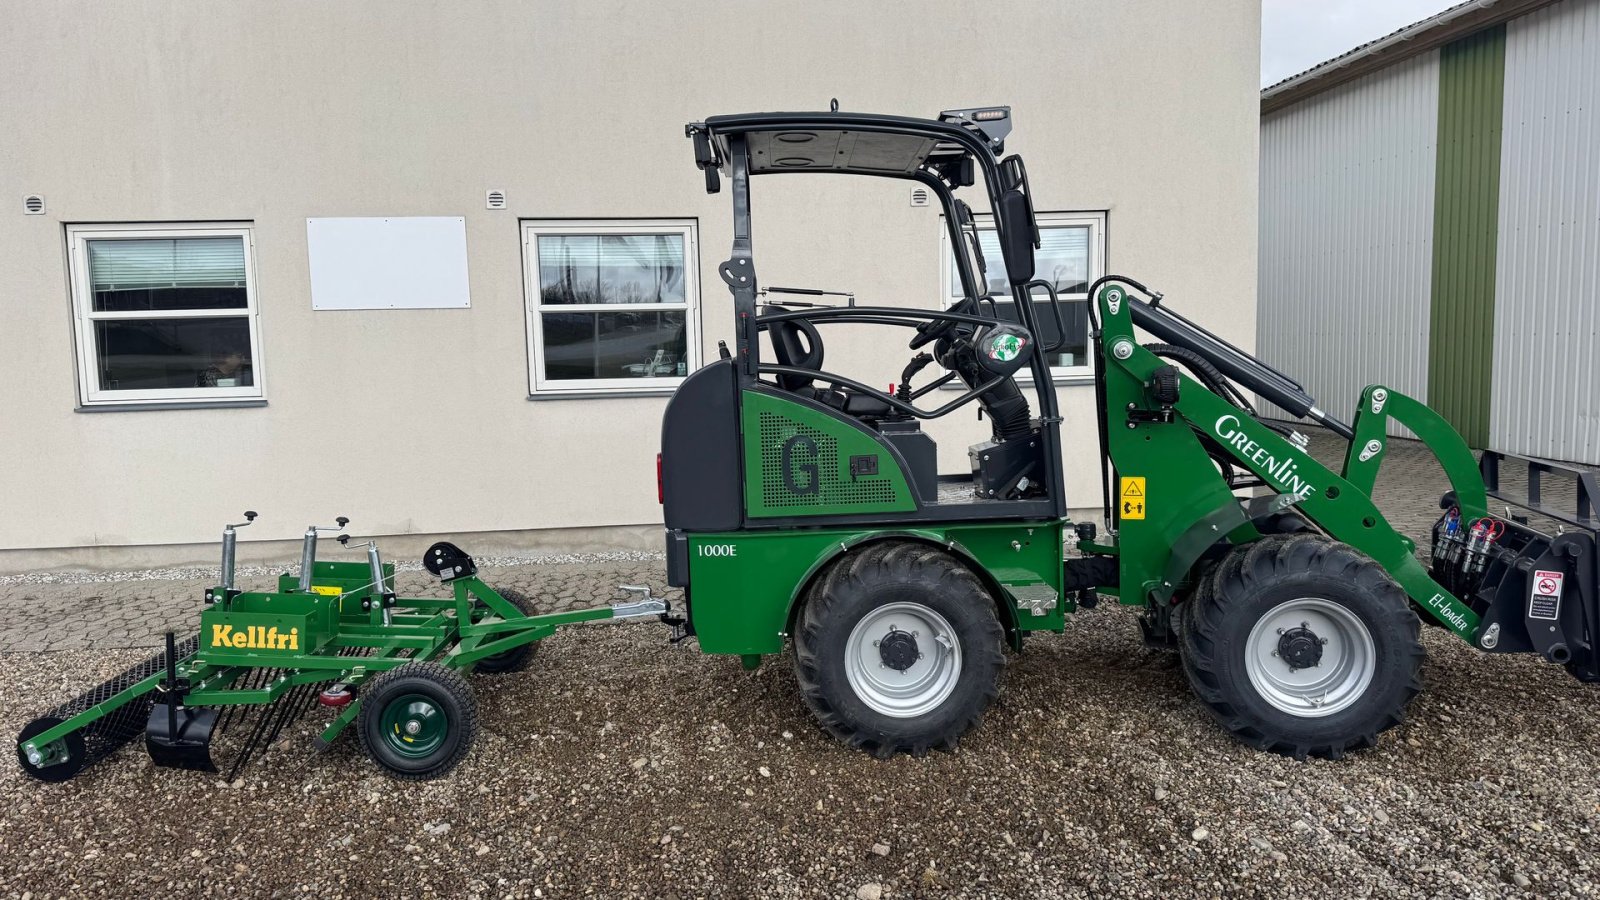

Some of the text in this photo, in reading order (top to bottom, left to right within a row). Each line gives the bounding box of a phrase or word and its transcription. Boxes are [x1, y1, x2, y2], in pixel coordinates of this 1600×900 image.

[782, 435, 820, 495] G
[697, 544, 737, 557] 1000E
[212, 624, 299, 650] Kellfri
